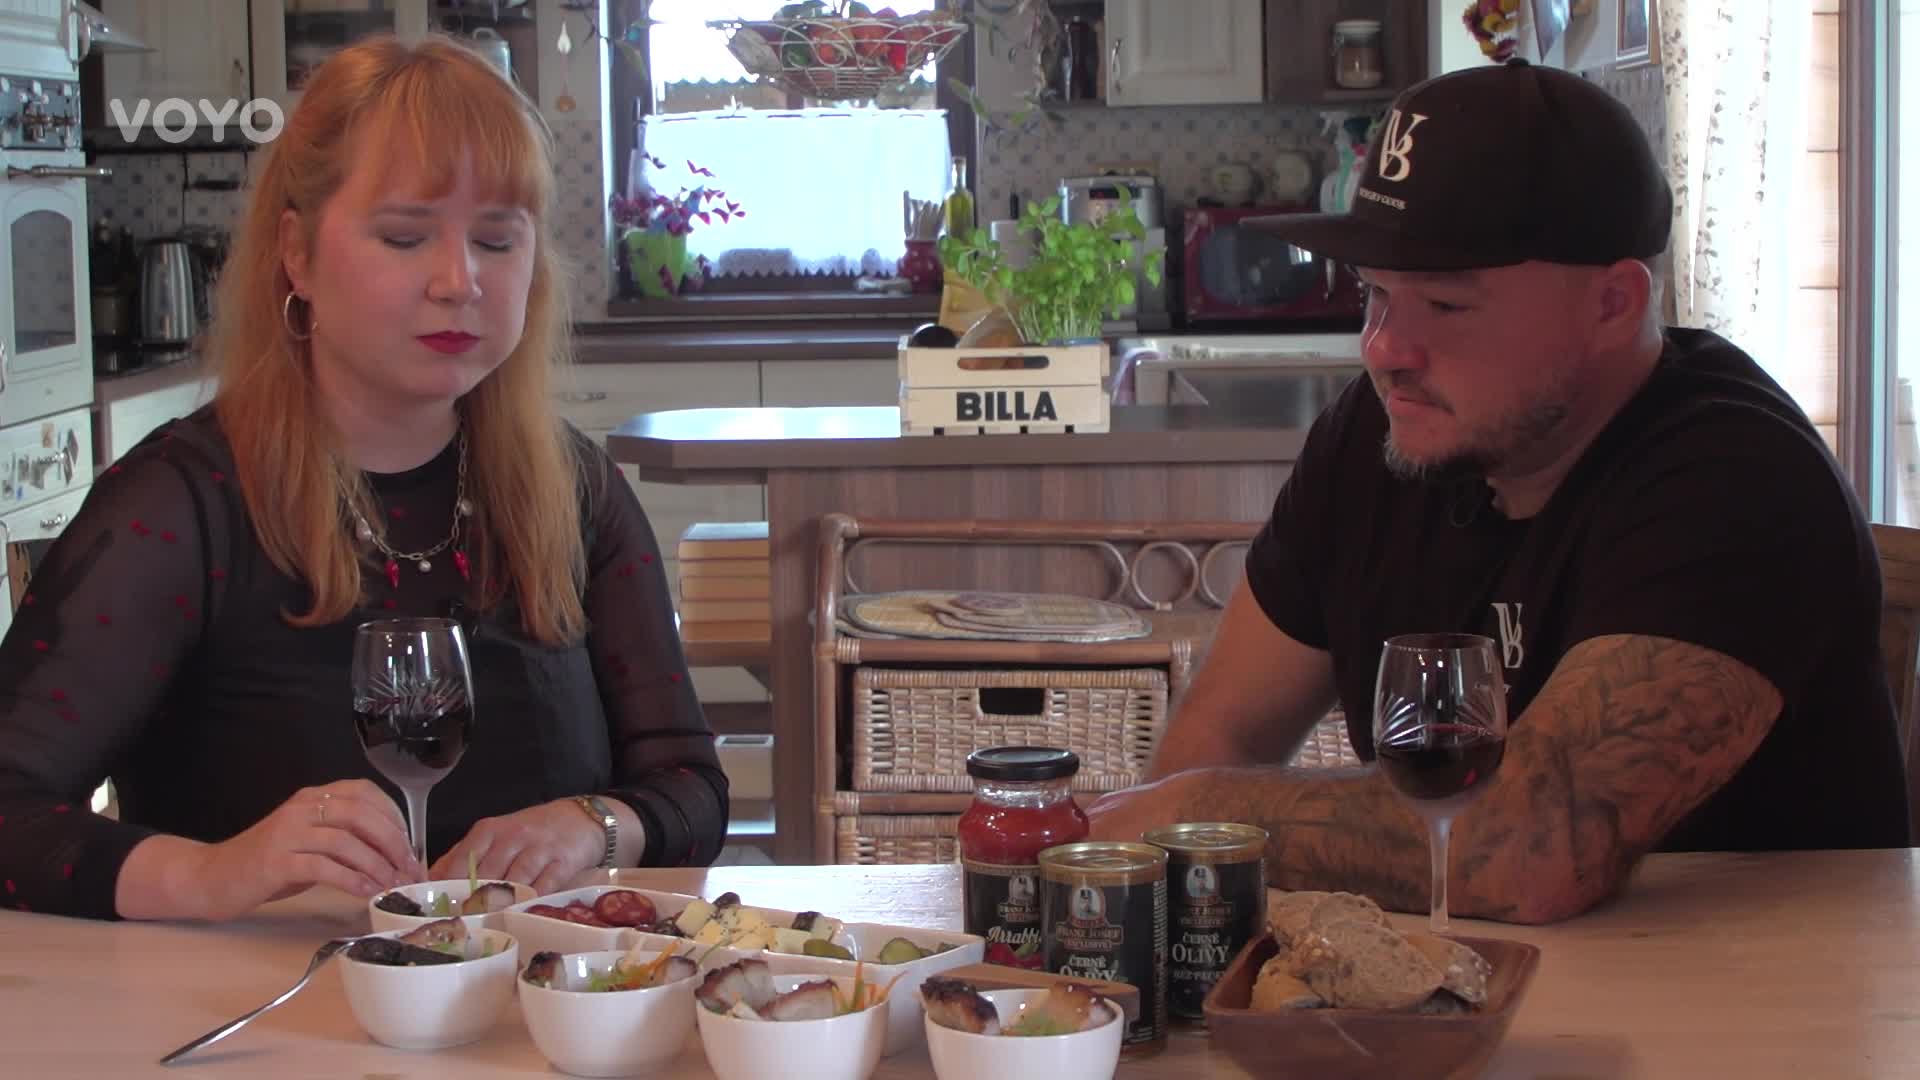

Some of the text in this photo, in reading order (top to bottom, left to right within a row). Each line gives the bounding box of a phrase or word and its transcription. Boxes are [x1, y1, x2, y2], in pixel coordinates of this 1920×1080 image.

[956, 391, 1058, 422] BILLA
[985, 925, 1042, 944] Arrabbi
[1172, 943, 1230, 964] OLIVY
